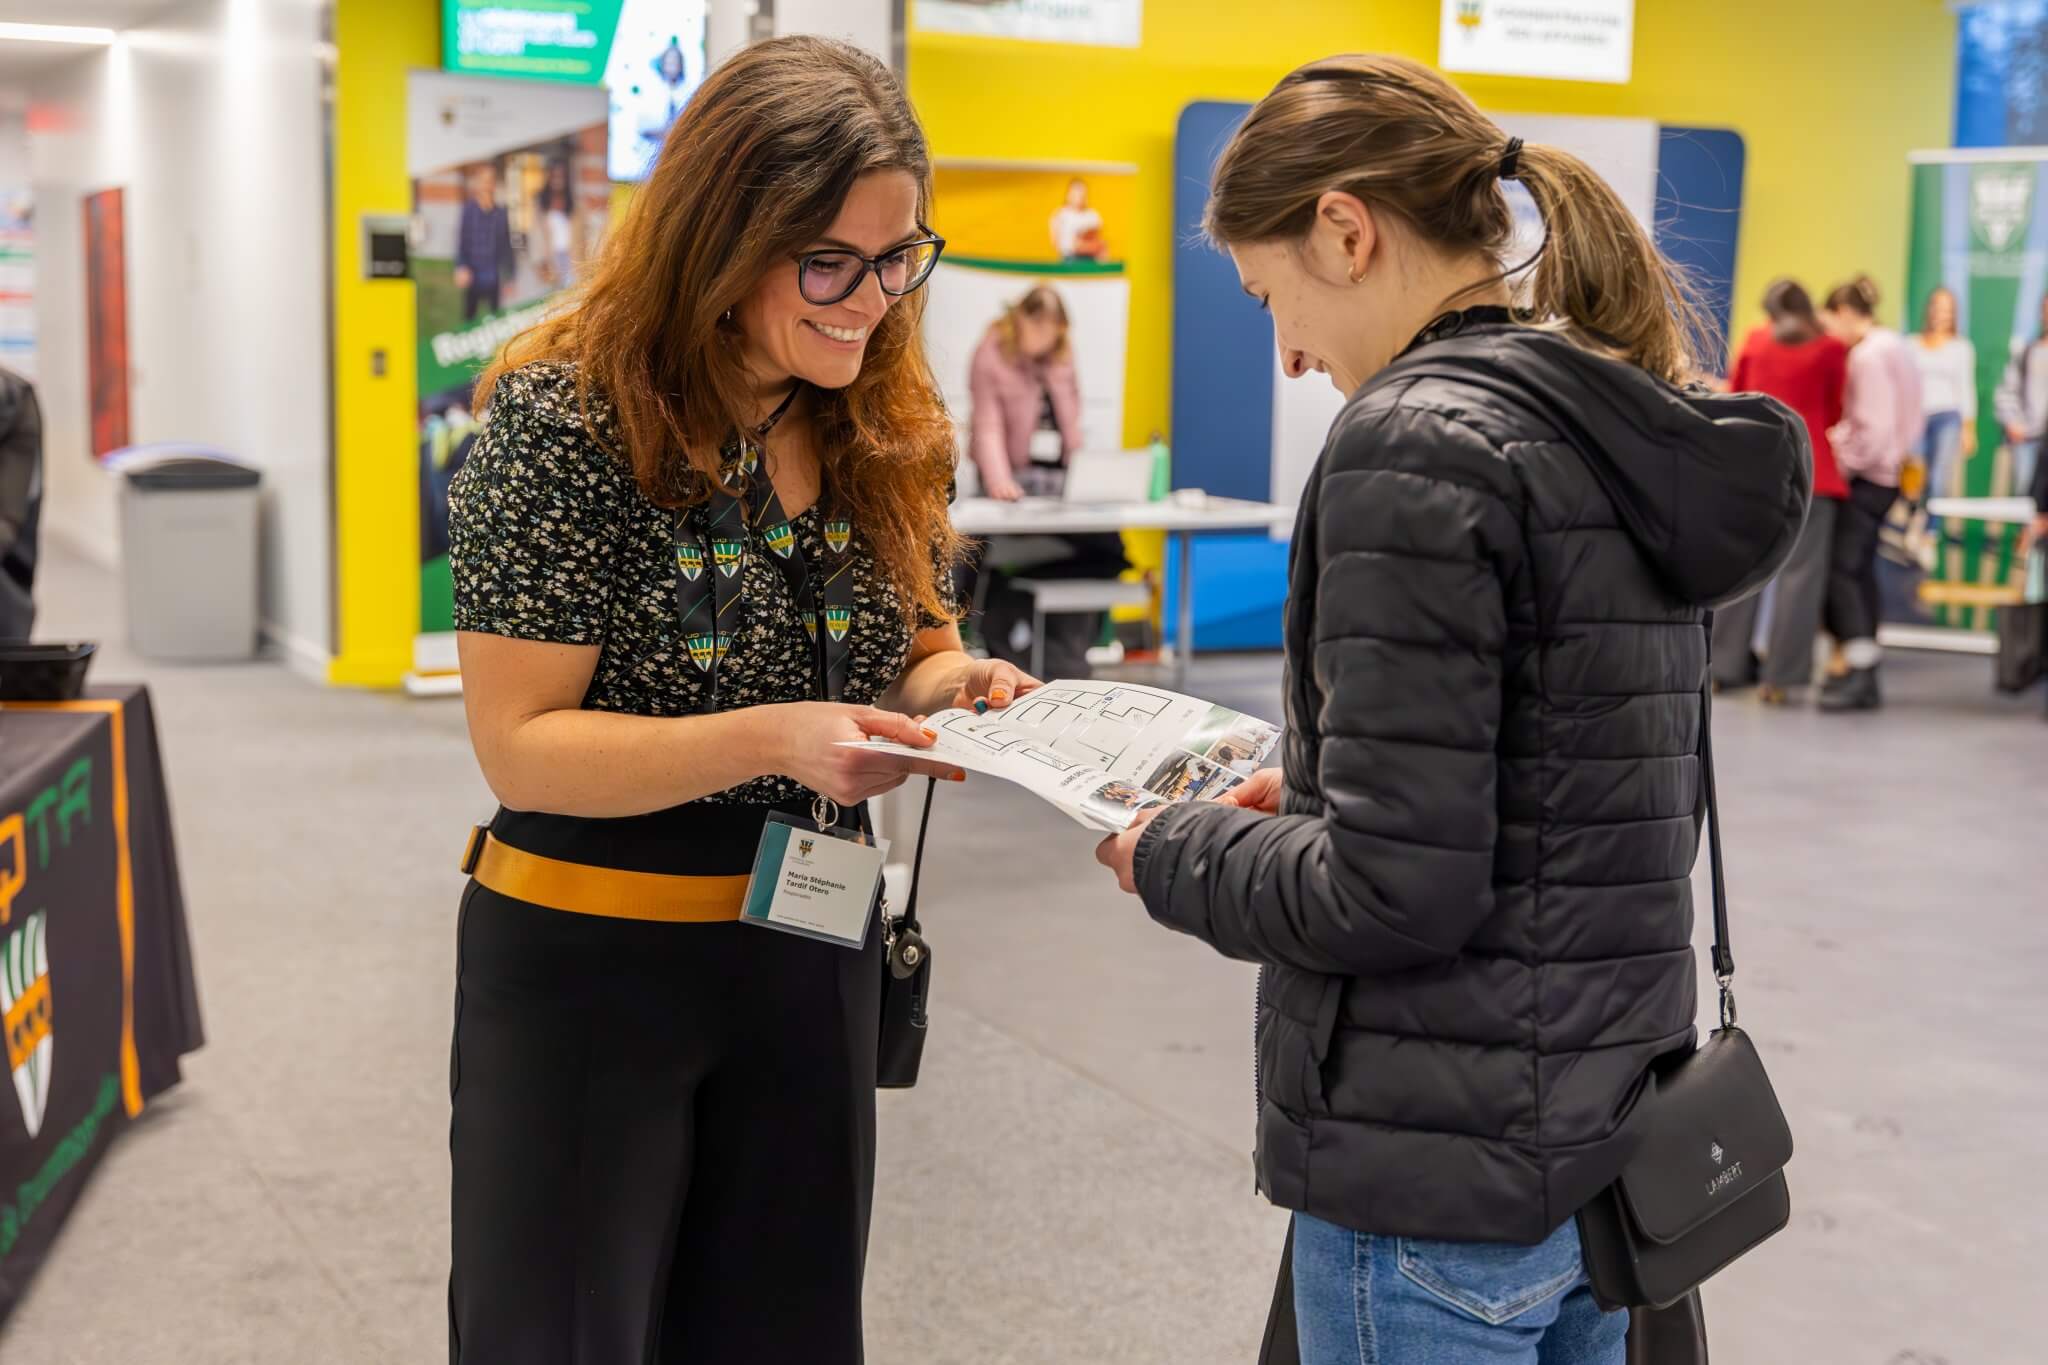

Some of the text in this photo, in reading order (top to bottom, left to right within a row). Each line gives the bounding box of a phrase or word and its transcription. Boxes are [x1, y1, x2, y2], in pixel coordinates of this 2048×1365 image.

[786, 879, 808, 890] Tardif
[808, 885, 829, 896] Otero
[1705, 1161, 1742, 1195] LAMBERT
